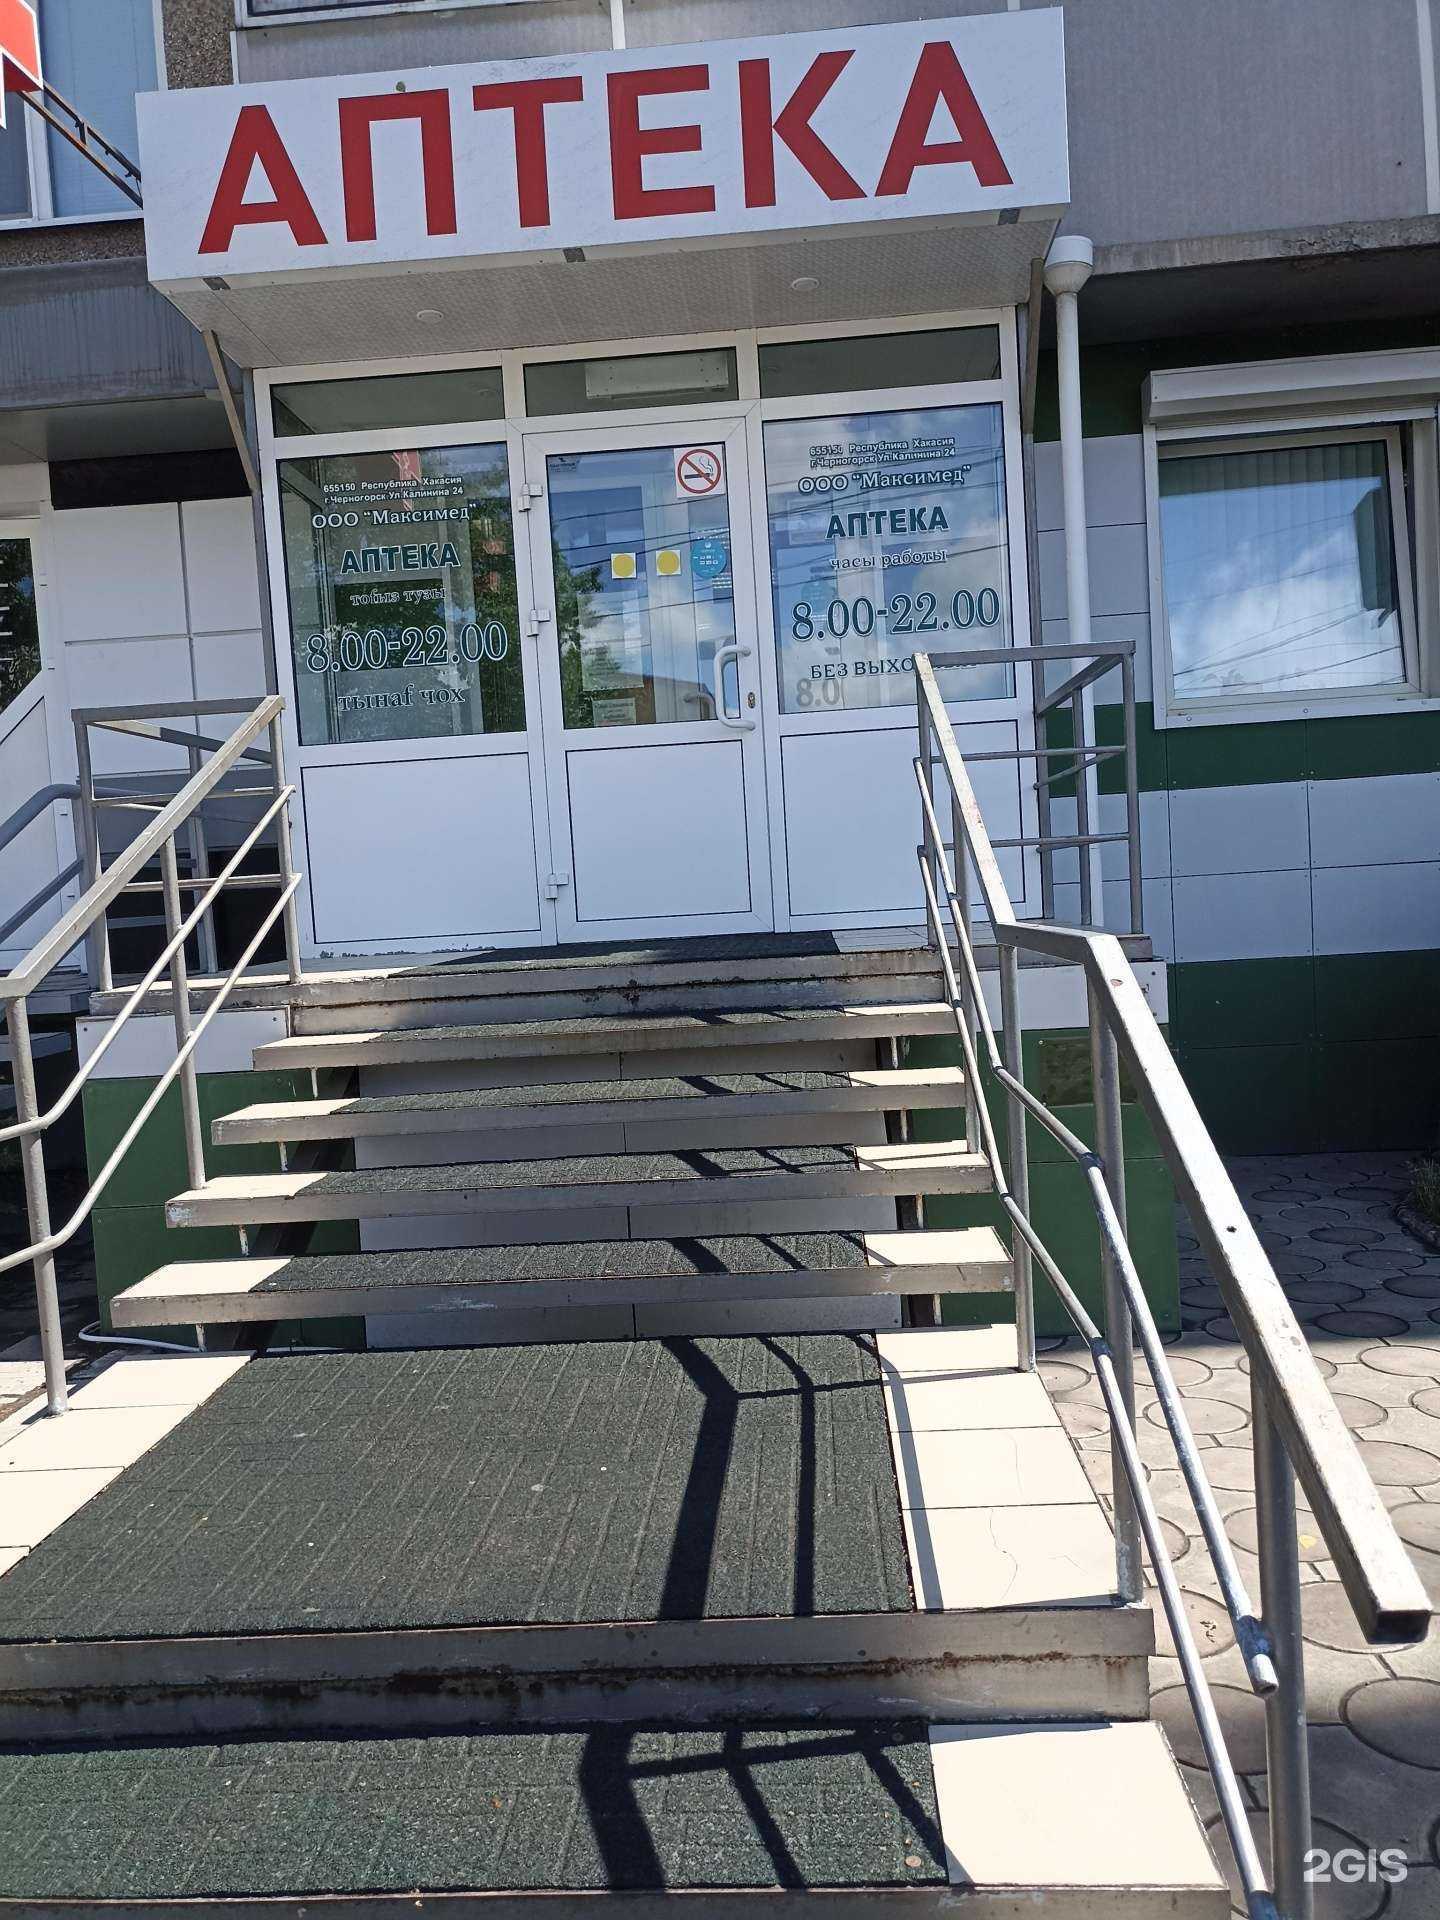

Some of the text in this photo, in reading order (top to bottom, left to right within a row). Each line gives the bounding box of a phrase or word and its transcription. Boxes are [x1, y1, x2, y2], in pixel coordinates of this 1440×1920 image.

[198, 40, 1014, 255] АПТЕКА
[849, 441, 908, 454] Республика
[913, 436, 955, 448] Хакасия
[944, 448, 955, 457] 24
[323, 475, 462, 493] 655150 Республика Хакасия
[452, 486, 464, 495] 24
[798, 475, 848, 493] ООО
[312, 512, 359, 529] ООО
[825, 505, 950, 540] АПТЕКА
[340, 542, 462, 575] АПТЕКА
[830, 549, 947, 570] часы работы
[791, 587, 1001, 641] 8.00-22.00
[306, 620, 509, 674] 8.00-22.00
[811, 657, 914, 680] БЕЗ ВЫХО
[418, 687, 466, 706] чох
